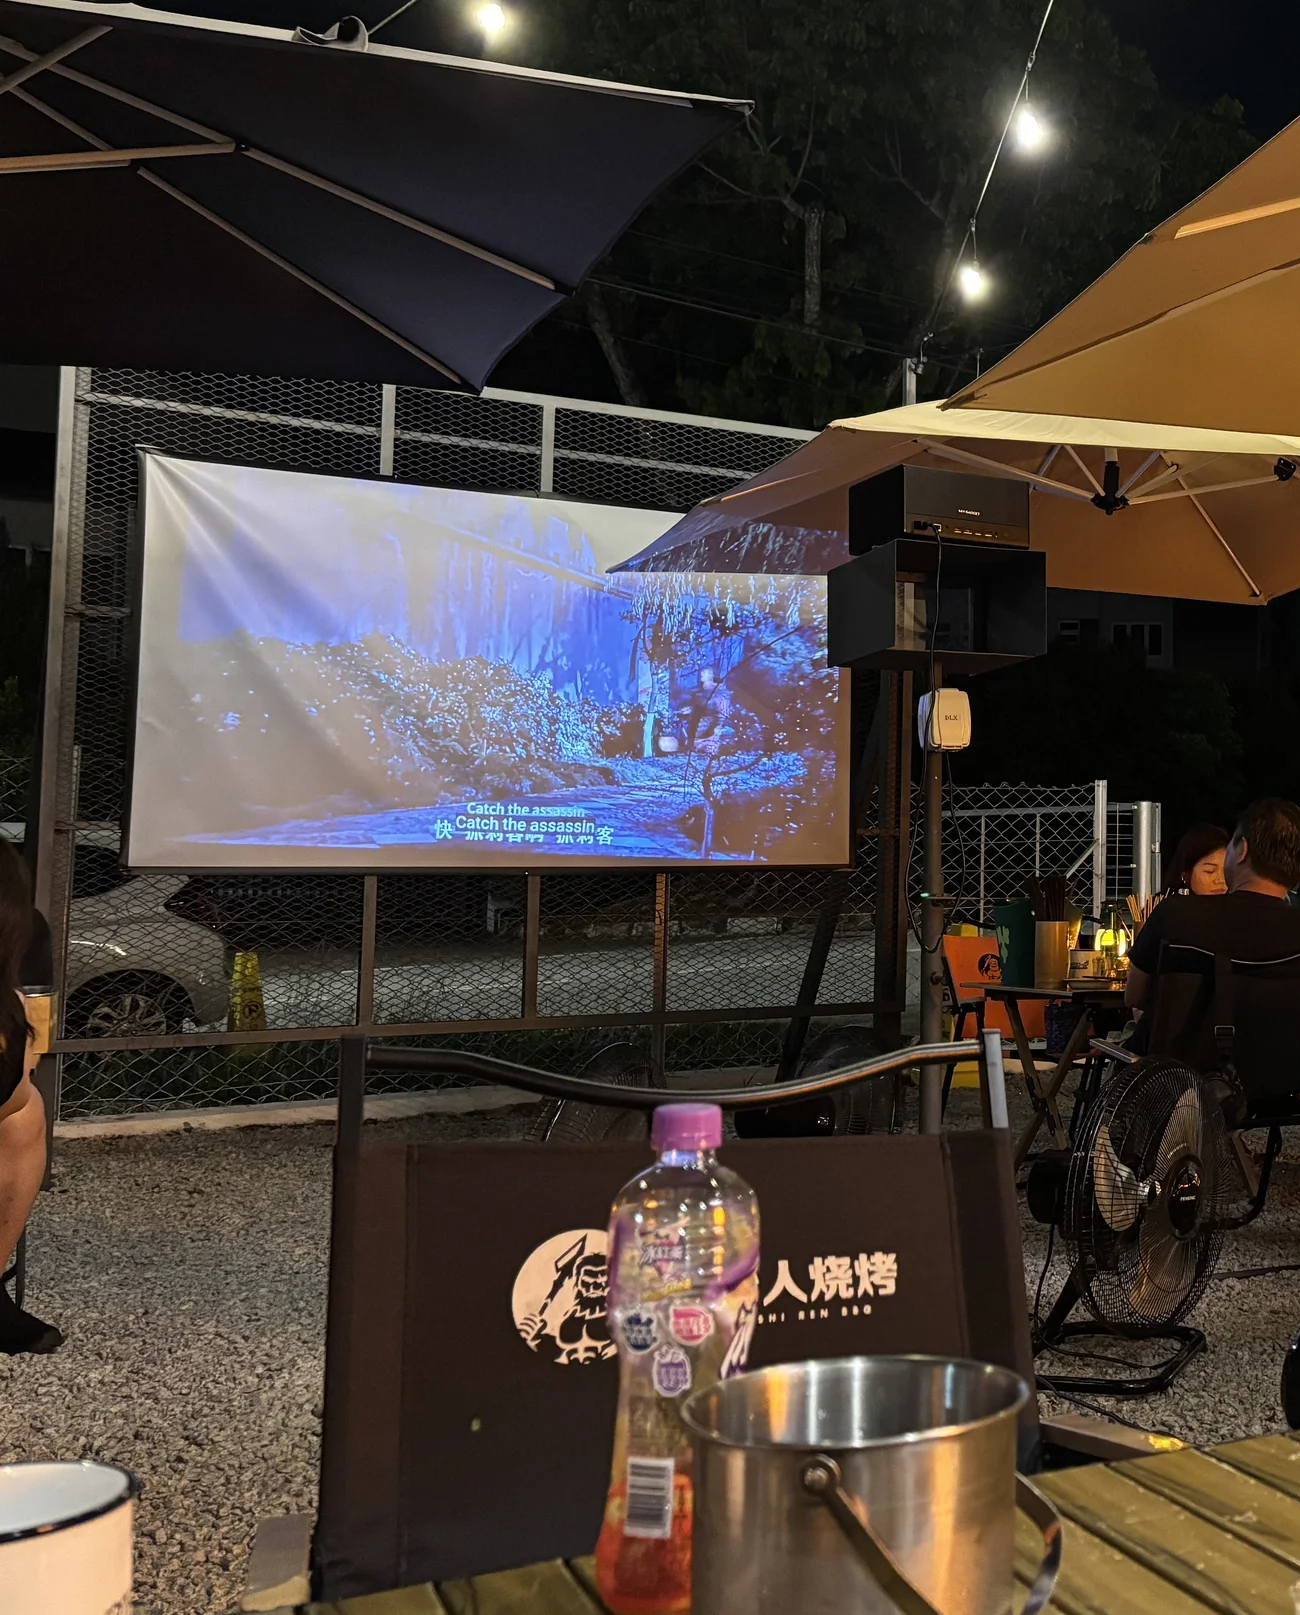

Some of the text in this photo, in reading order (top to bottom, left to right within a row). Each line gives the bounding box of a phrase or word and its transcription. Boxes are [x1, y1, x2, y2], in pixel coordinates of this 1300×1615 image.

[466, 801, 585, 818] Catch the assassin
[434, 819, 453, 840] 快
[455, 815, 595, 834] Catch the assassin
[757, 1251, 898, 1307] 人烧烤
[758, 1312, 786, 1325] SHI
[798, 1308, 829, 1321] REN
